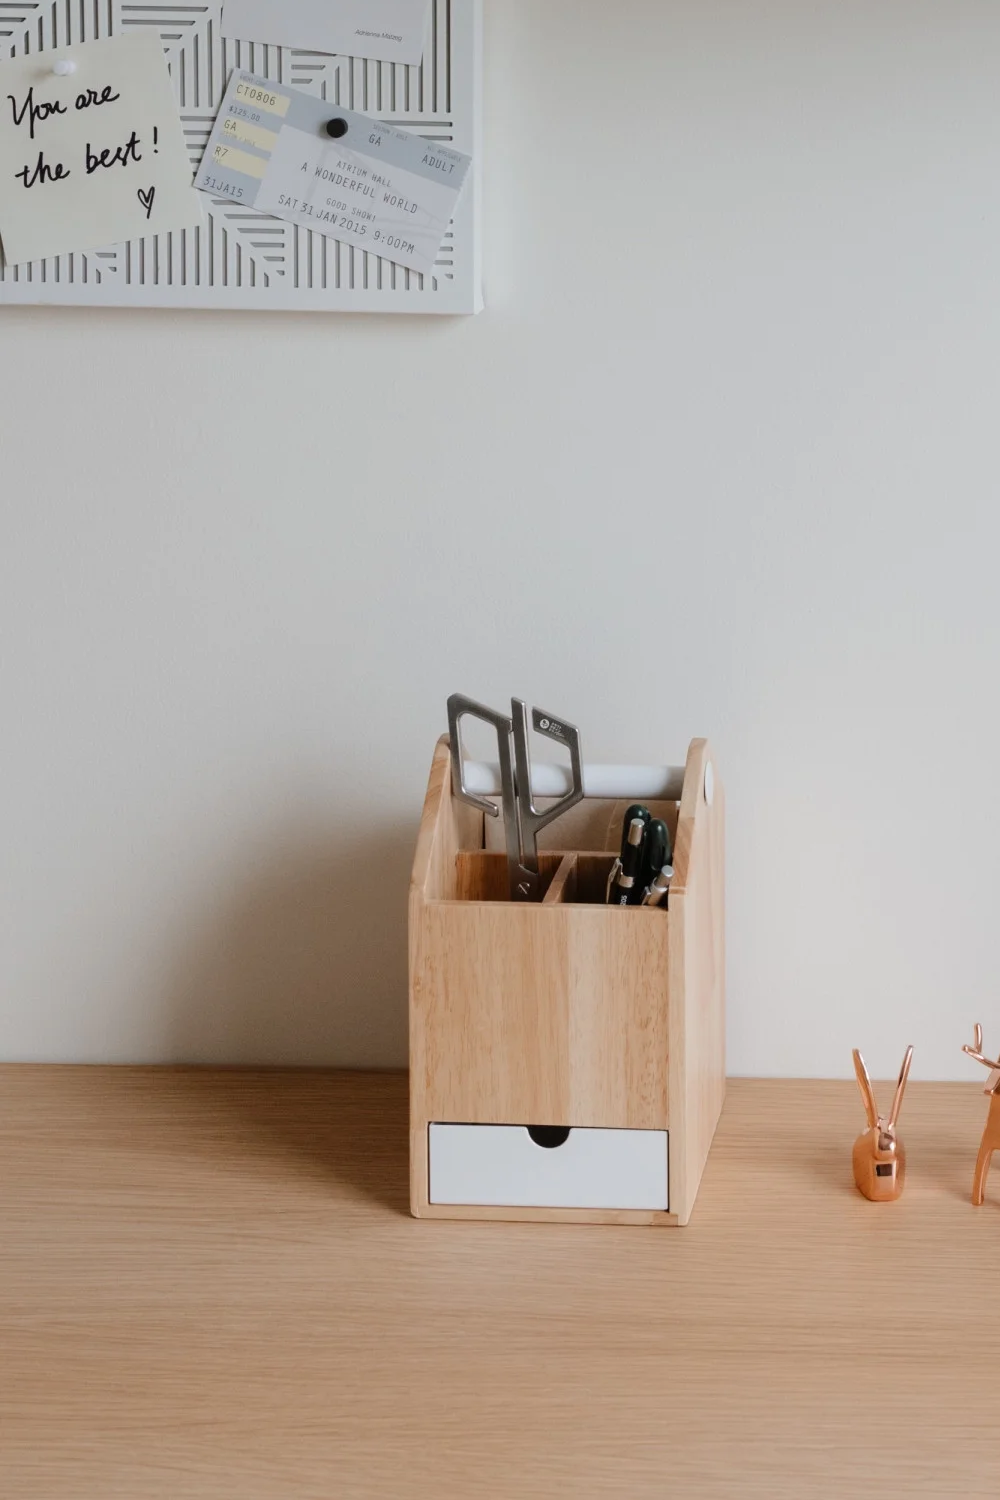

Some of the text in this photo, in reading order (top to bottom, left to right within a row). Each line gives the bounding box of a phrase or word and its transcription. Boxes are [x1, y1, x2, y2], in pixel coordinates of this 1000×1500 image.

[236, 84, 277, 106] CT0806
[7, 86, 120, 139] You are
[228, 105, 261, 122] $125.00
[224, 119, 237, 131] GA
[368, 133, 382, 146] GA
[214, 146, 228, 157] R7
[15, 151, 70, 188] the
[336, 160, 392, 188] ATRIUM HALL
[421, 154, 456, 174] ADULT
[203, 176, 244, 198] 31JA15
[301, 162, 419, 214] A WONDERFUL WORLD
[326, 198, 377, 222] GOOD SHOW!
[278, 195, 415, 254] SAT 31 JAN 2015 9:00PM
